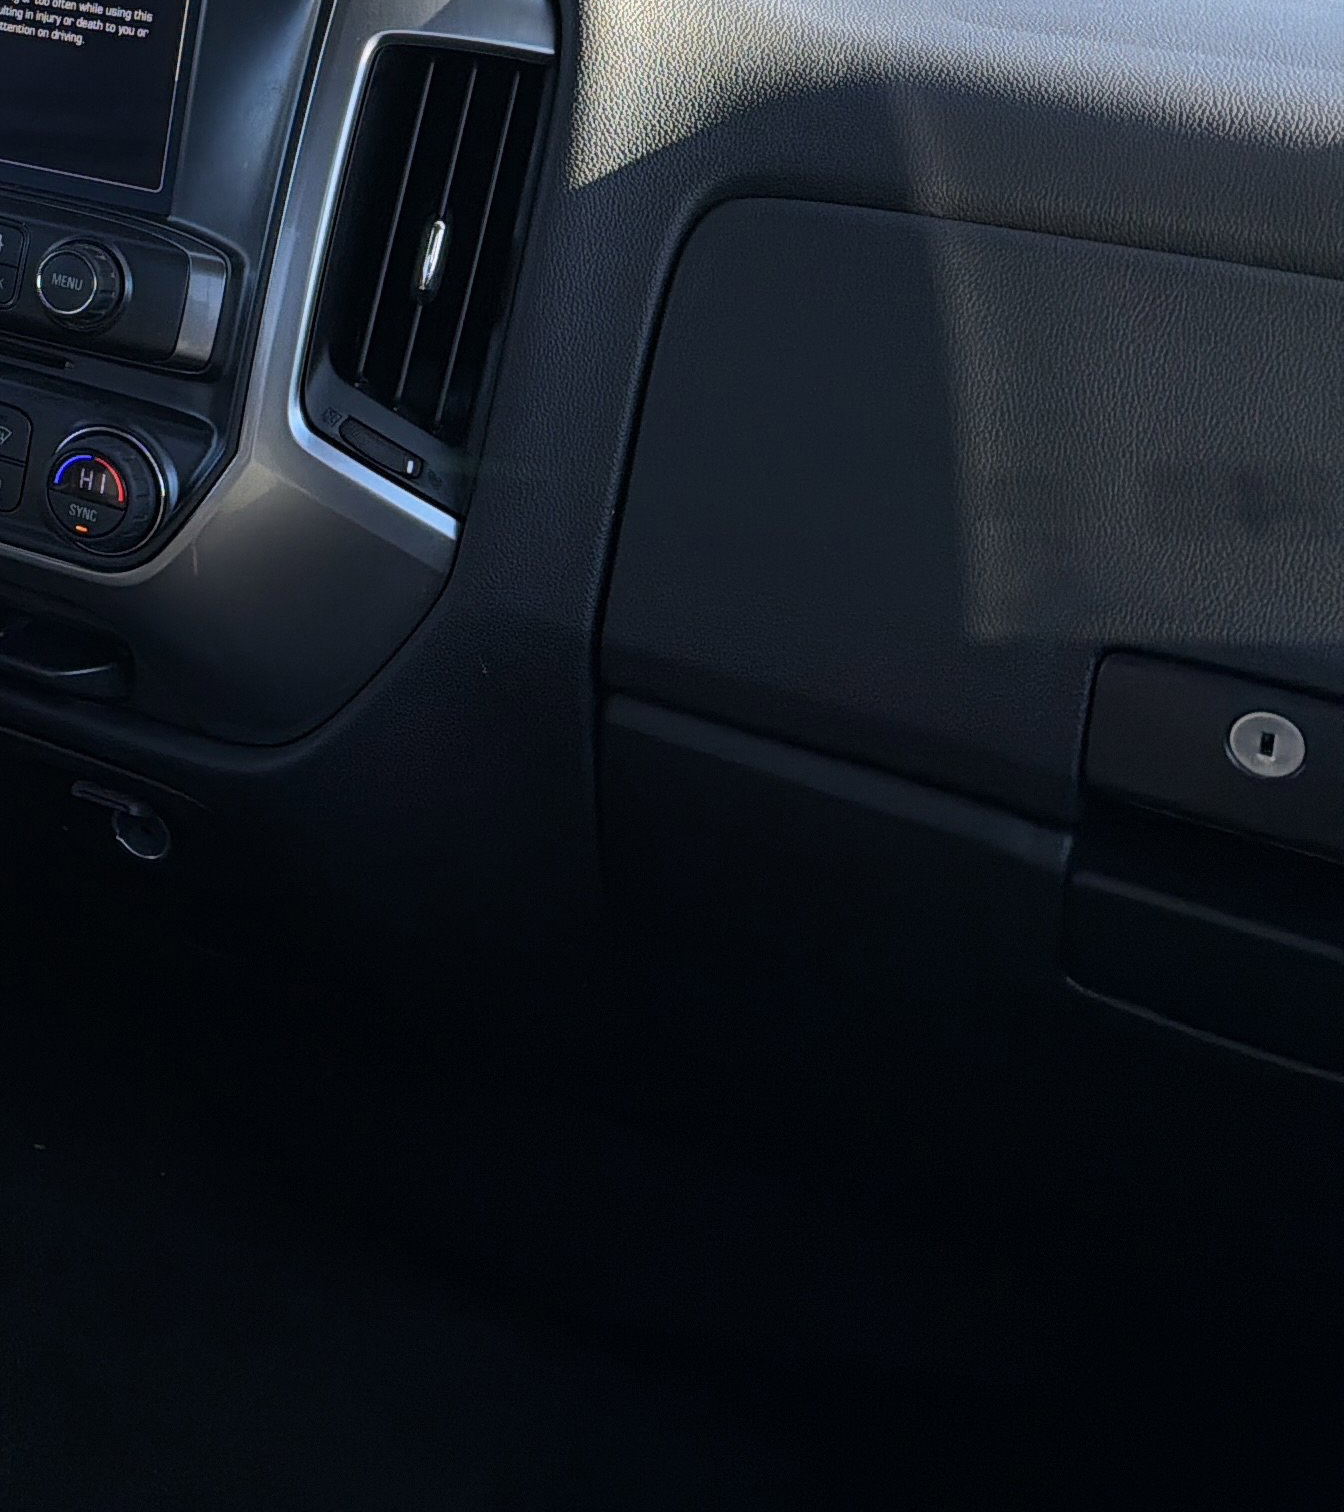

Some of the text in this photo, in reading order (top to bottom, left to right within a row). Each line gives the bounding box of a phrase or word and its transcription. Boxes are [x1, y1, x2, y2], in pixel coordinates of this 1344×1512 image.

[79, 1, 103, 14] while
[105, 6, 132, 22] using
[134, 8, 154, 23] this
[25, 8, 34, 20] in
[35, 9, 62, 26] injury
[63, 16, 75, 26] or
[76, 16, 103, 31] death
[105, 21, 116, 33] to
[118, 25, 135, 37] you
[137, 28, 149, 38] or
[37, 28, 50, 39] on
[51, 29, 85, 47] driving.
[51, 272, 84, 291] MENU
[79, 467, 107, 495] HI
[69, 503, 98, 522] SYNC
